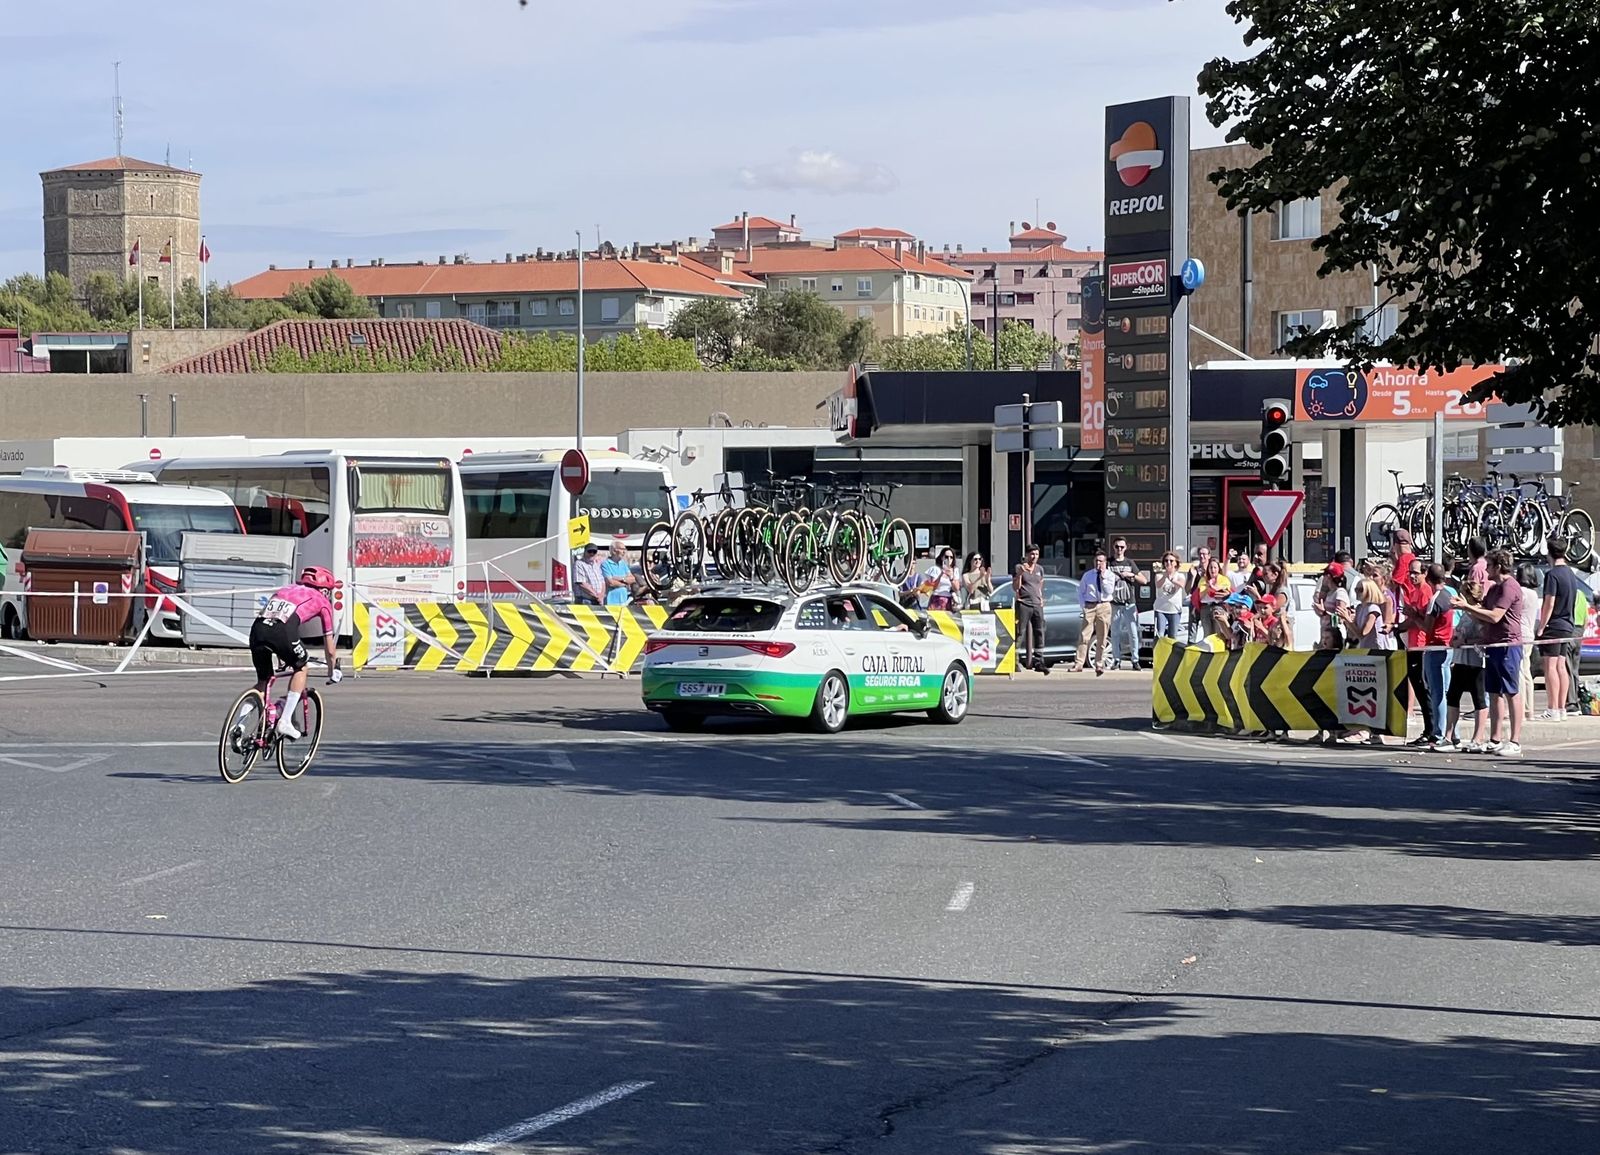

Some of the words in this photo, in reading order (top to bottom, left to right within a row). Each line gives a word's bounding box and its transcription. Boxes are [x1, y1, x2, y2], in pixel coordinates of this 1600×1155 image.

[1109, 194, 1165, 216] REPSOL
[1111, 265, 1163, 286] SUPERCOR
[1082, 360, 1094, 390] 5
[1372, 370, 1428, 386] Ahorra
[1392, 390, 1411, 415] 5
[1082, 400, 1105, 431] 20
[862, 655, 888, 675] CAJA
[892, 655, 926, 673] RURAL
[864, 675, 898, 687] SEGUROS
[898, 675, 921, 687] RGA
